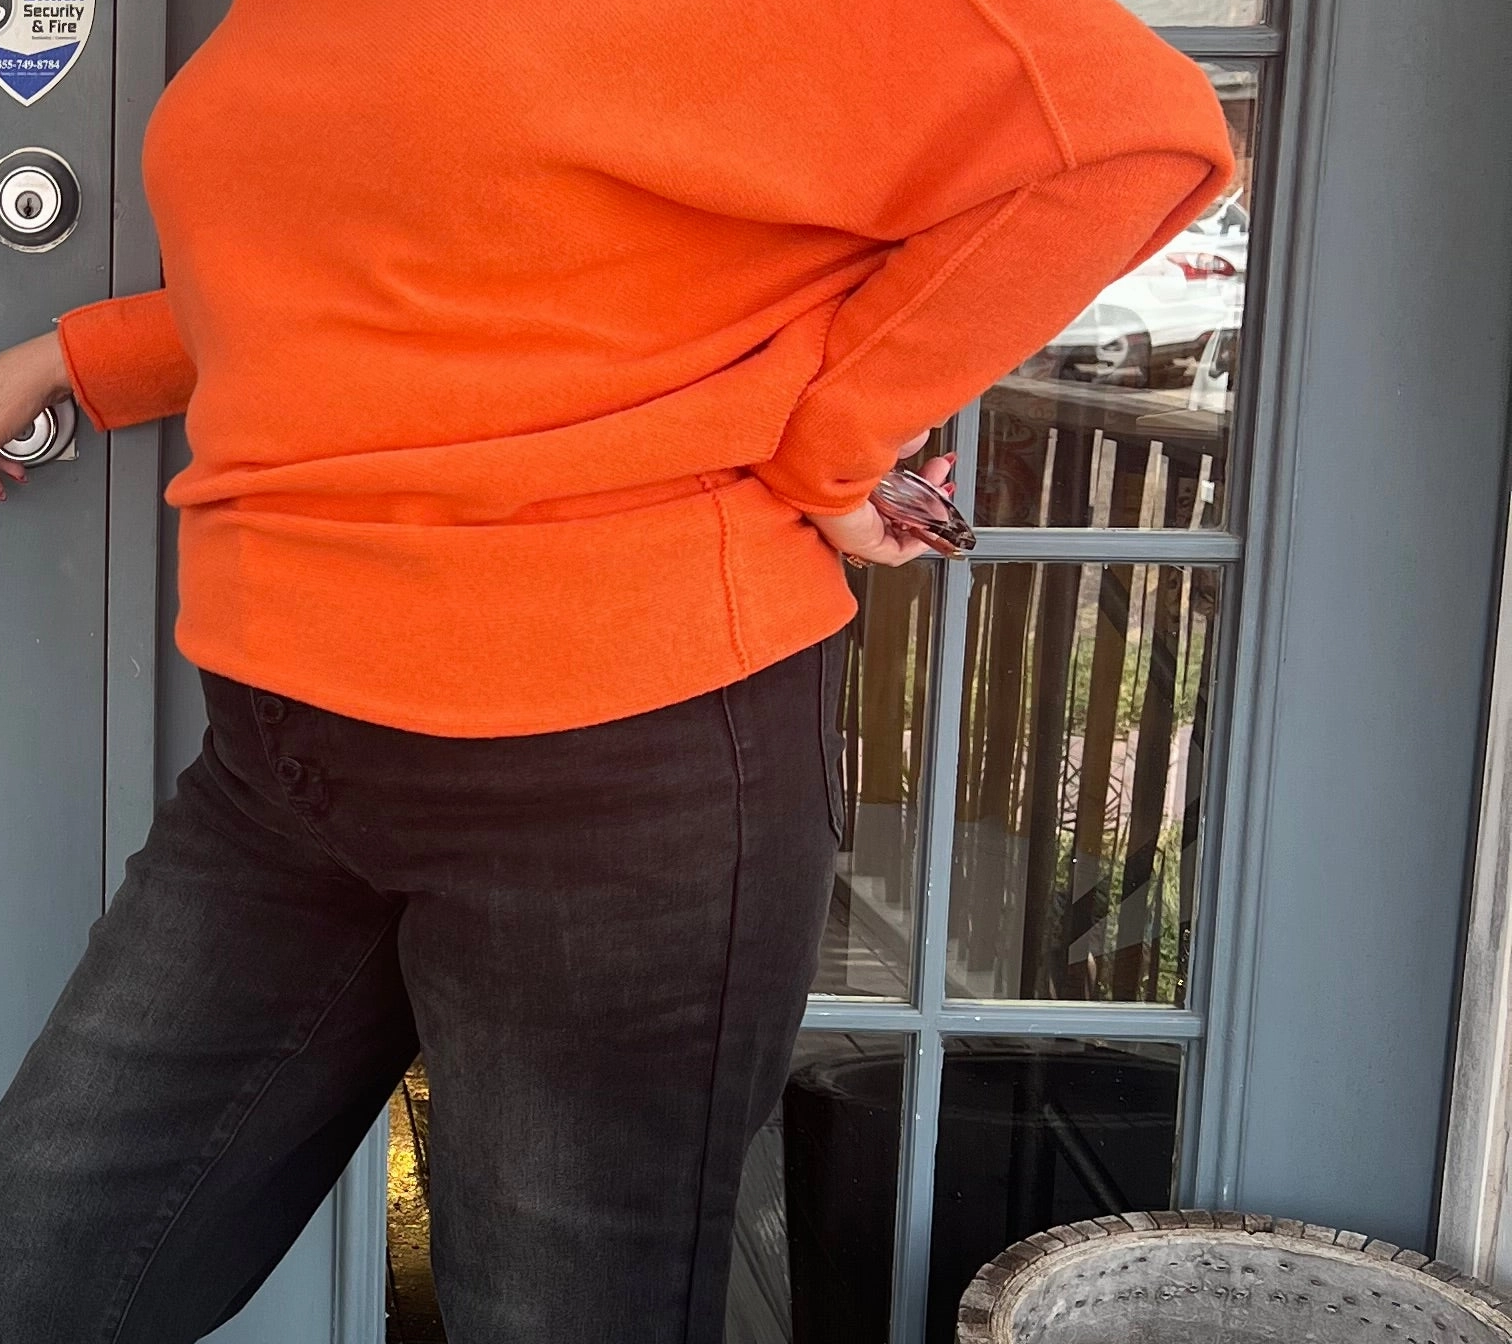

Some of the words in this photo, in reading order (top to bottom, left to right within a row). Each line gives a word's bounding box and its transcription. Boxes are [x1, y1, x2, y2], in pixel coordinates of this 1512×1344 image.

[23, 5, 85, 21] Security
[32, 21, 44, 34] &
[49, 20, 77, 34] Fire
